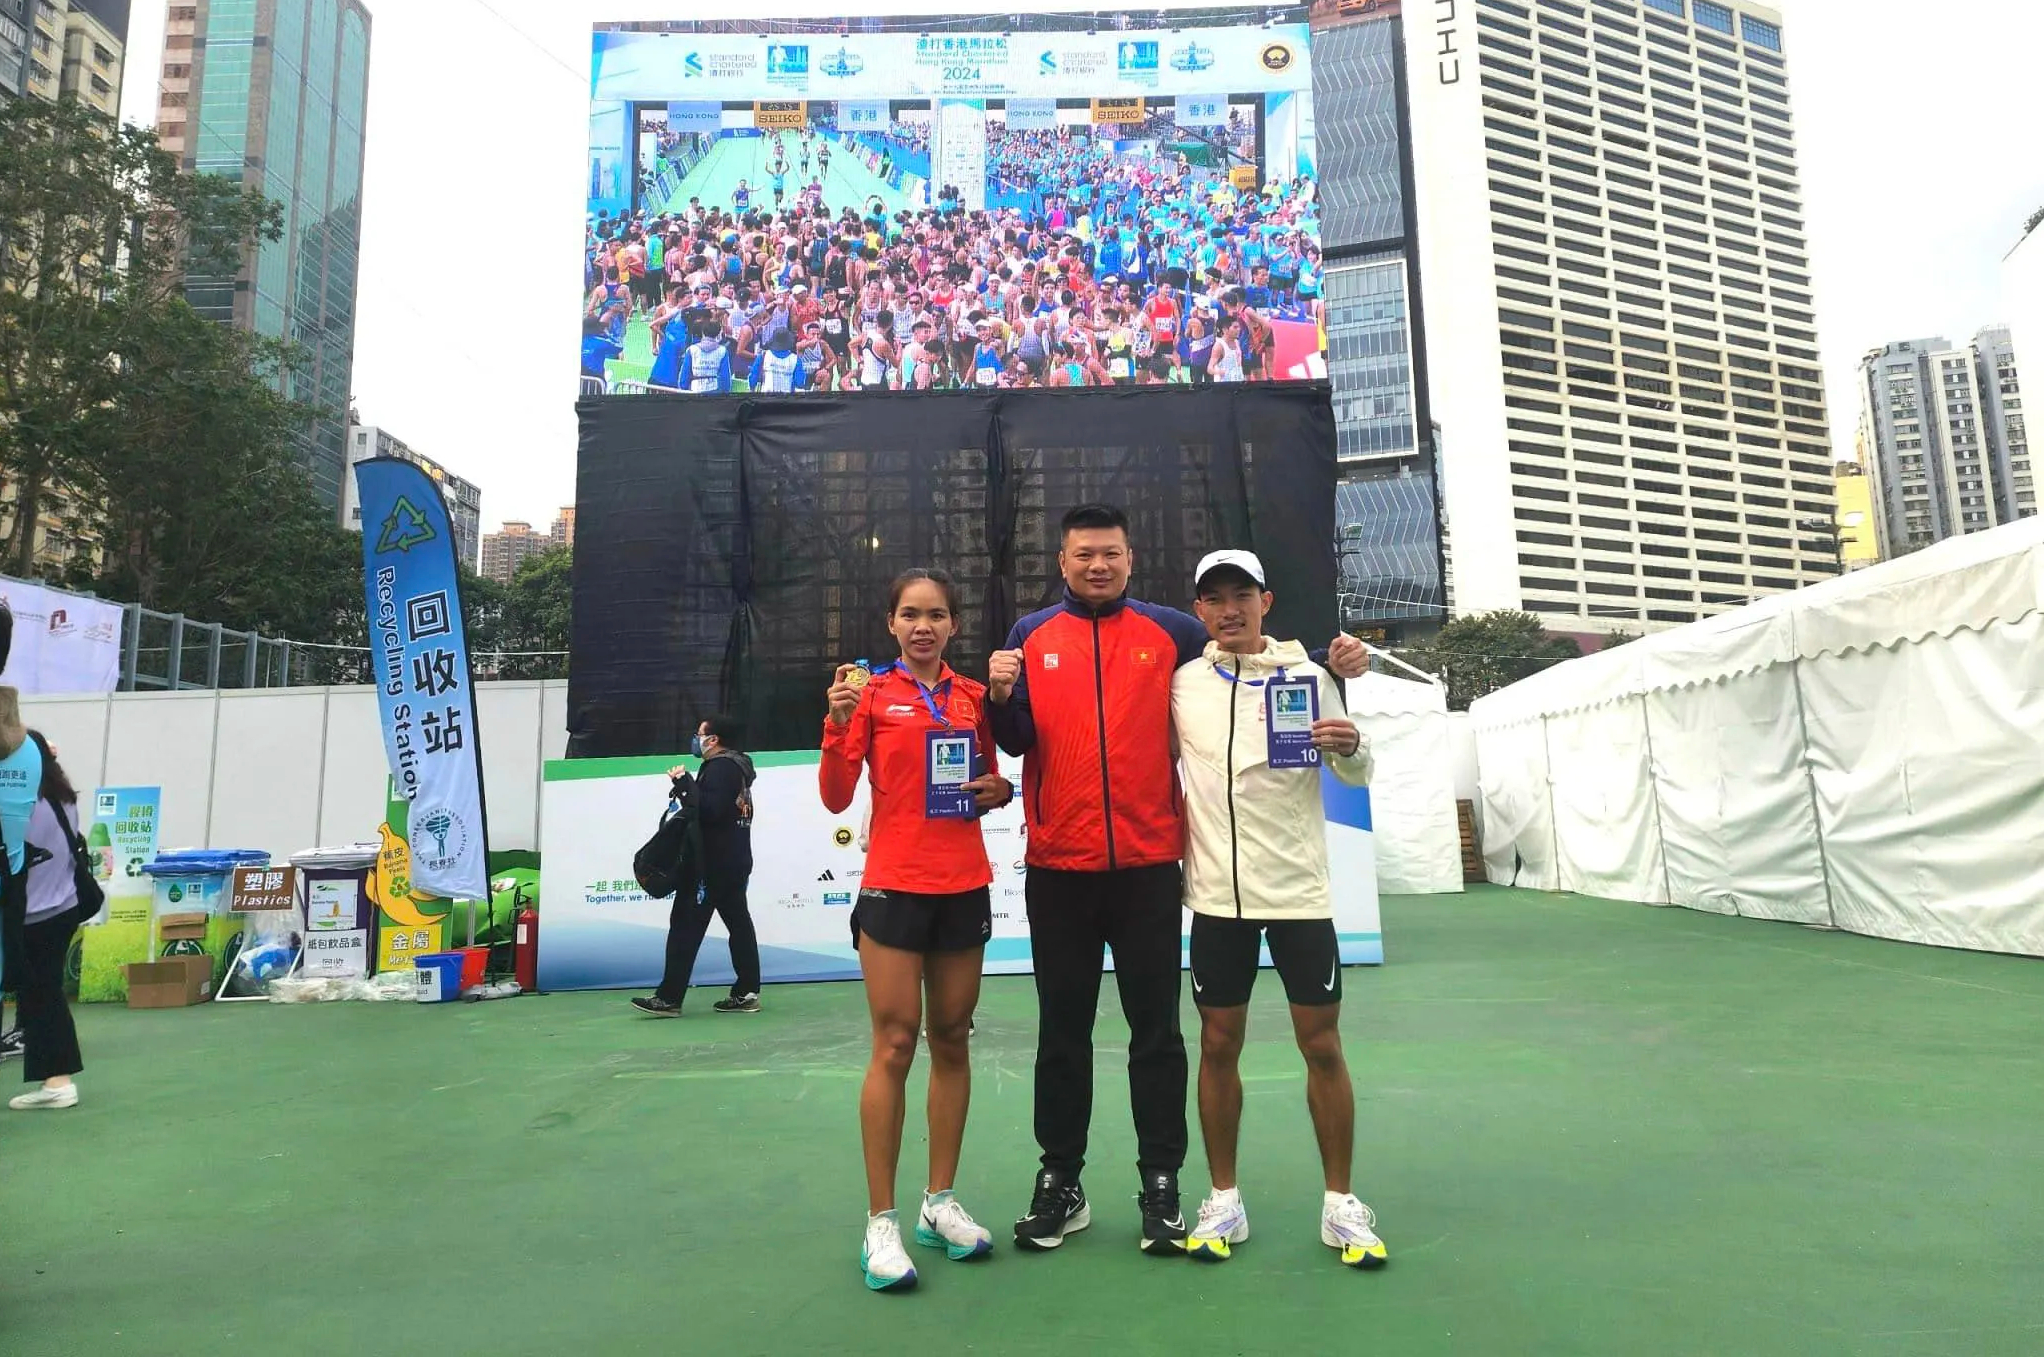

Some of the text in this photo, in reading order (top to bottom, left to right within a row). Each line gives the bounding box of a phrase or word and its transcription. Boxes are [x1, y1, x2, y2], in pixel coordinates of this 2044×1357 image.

[943, 67, 981, 80] 2024
[850, 109, 878, 122] 香港
[1097, 110, 1140, 120] SEIKO
[1188, 104, 1216, 117] 香港
[759, 113, 802, 123] SEIKO
[405, 589, 463, 755] 回收站
[376, 565, 418, 801] Recycling Station
[1300, 748, 1318, 763] 10
[956, 799, 969, 813] 11
[115, 821, 152, 834] 回收站
[117, 836, 151, 844] Recycling
[125, 846, 150, 854] Station
[244, 872, 284, 891] 塑膠
[585, 880, 607, 892] 一起
[233, 895, 291, 907] Plastics
[585, 894, 627, 905] Together,
[629, 894, 643, 902] we
[307, 936, 363, 951] 紙包飲品盒
[392, 929, 430, 951] 金屬
